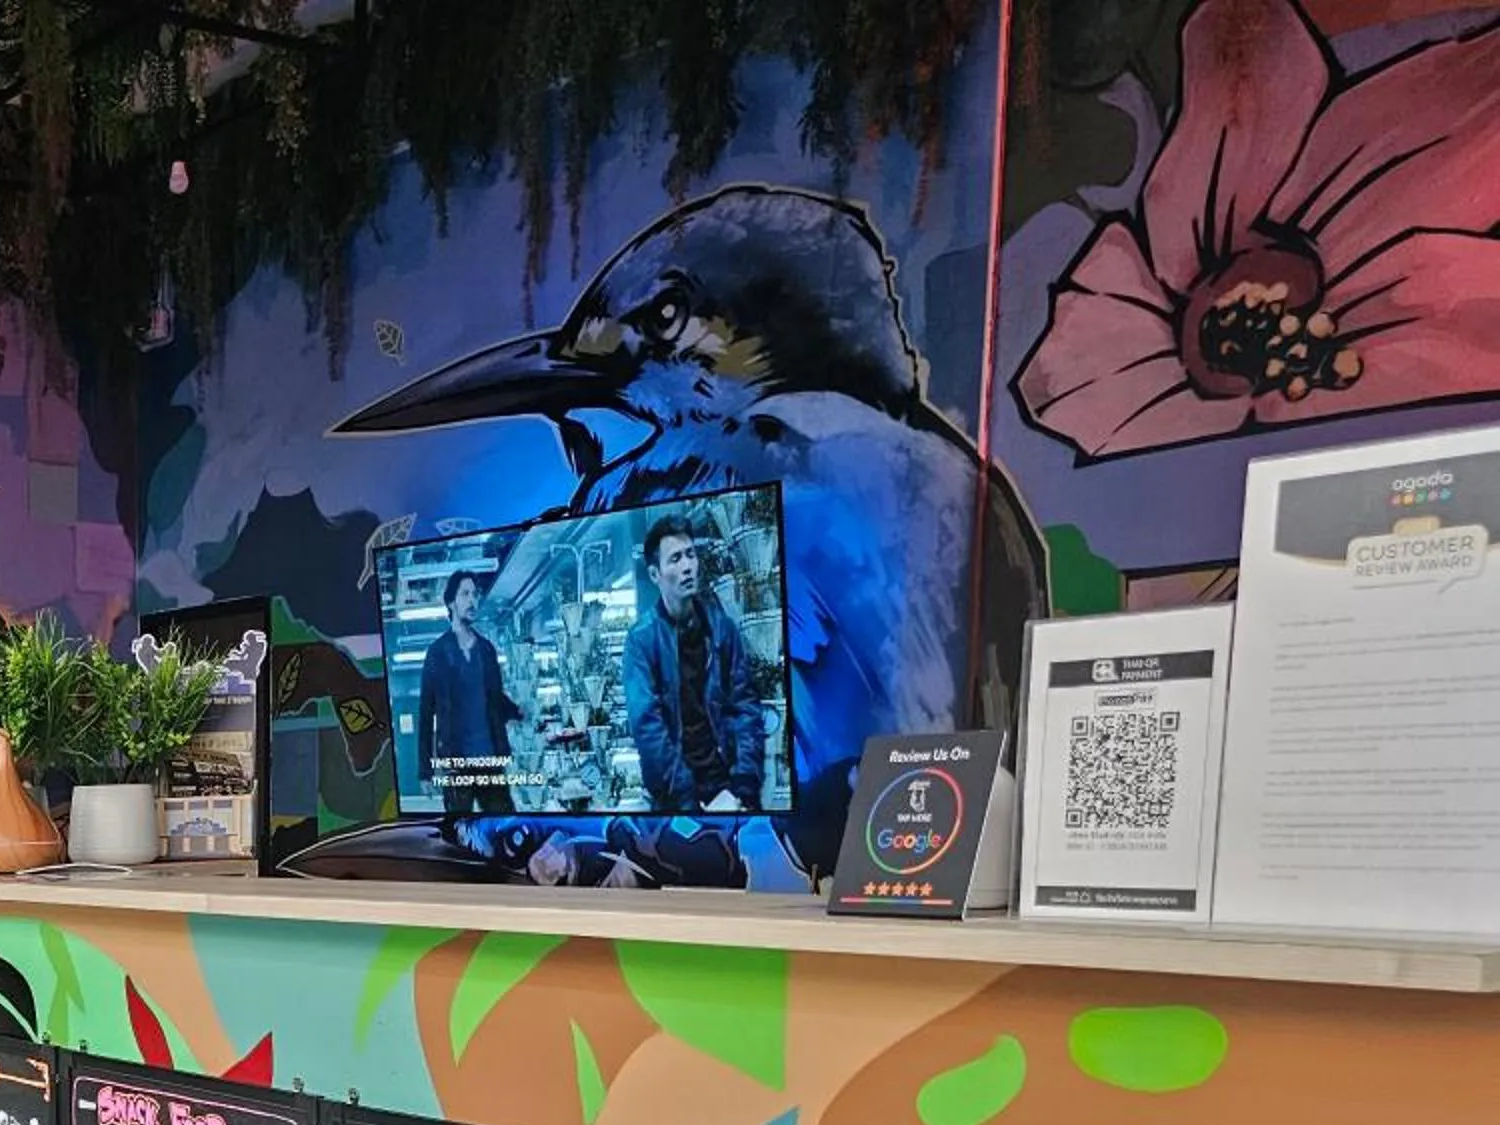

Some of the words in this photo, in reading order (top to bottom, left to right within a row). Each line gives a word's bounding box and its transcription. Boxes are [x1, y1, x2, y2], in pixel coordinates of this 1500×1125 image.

[1392, 469, 1454, 492] agoda
[1356, 535, 1475, 562] CUSTOMER
[1355, 560, 1414, 577] REVIEW
[1416, 556, 1474, 573] AWARD
[430, 757, 451, 769] TIME
[452, 757, 465, 768] TO
[466, 755, 513, 767] PROGRAM
[890, 749, 930, 763] Review
[933, 748, 948, 761] Us
[950, 746, 970, 761] On
[432, 776, 450, 787] THE
[451, 775, 475, 786] LOOP
[476, 775, 489, 785] SO
[491, 774, 506, 785] WE
[507, 773, 527, 785] CAN
[528, 773, 543, 785] GO
[877, 829, 941, 853] Google
